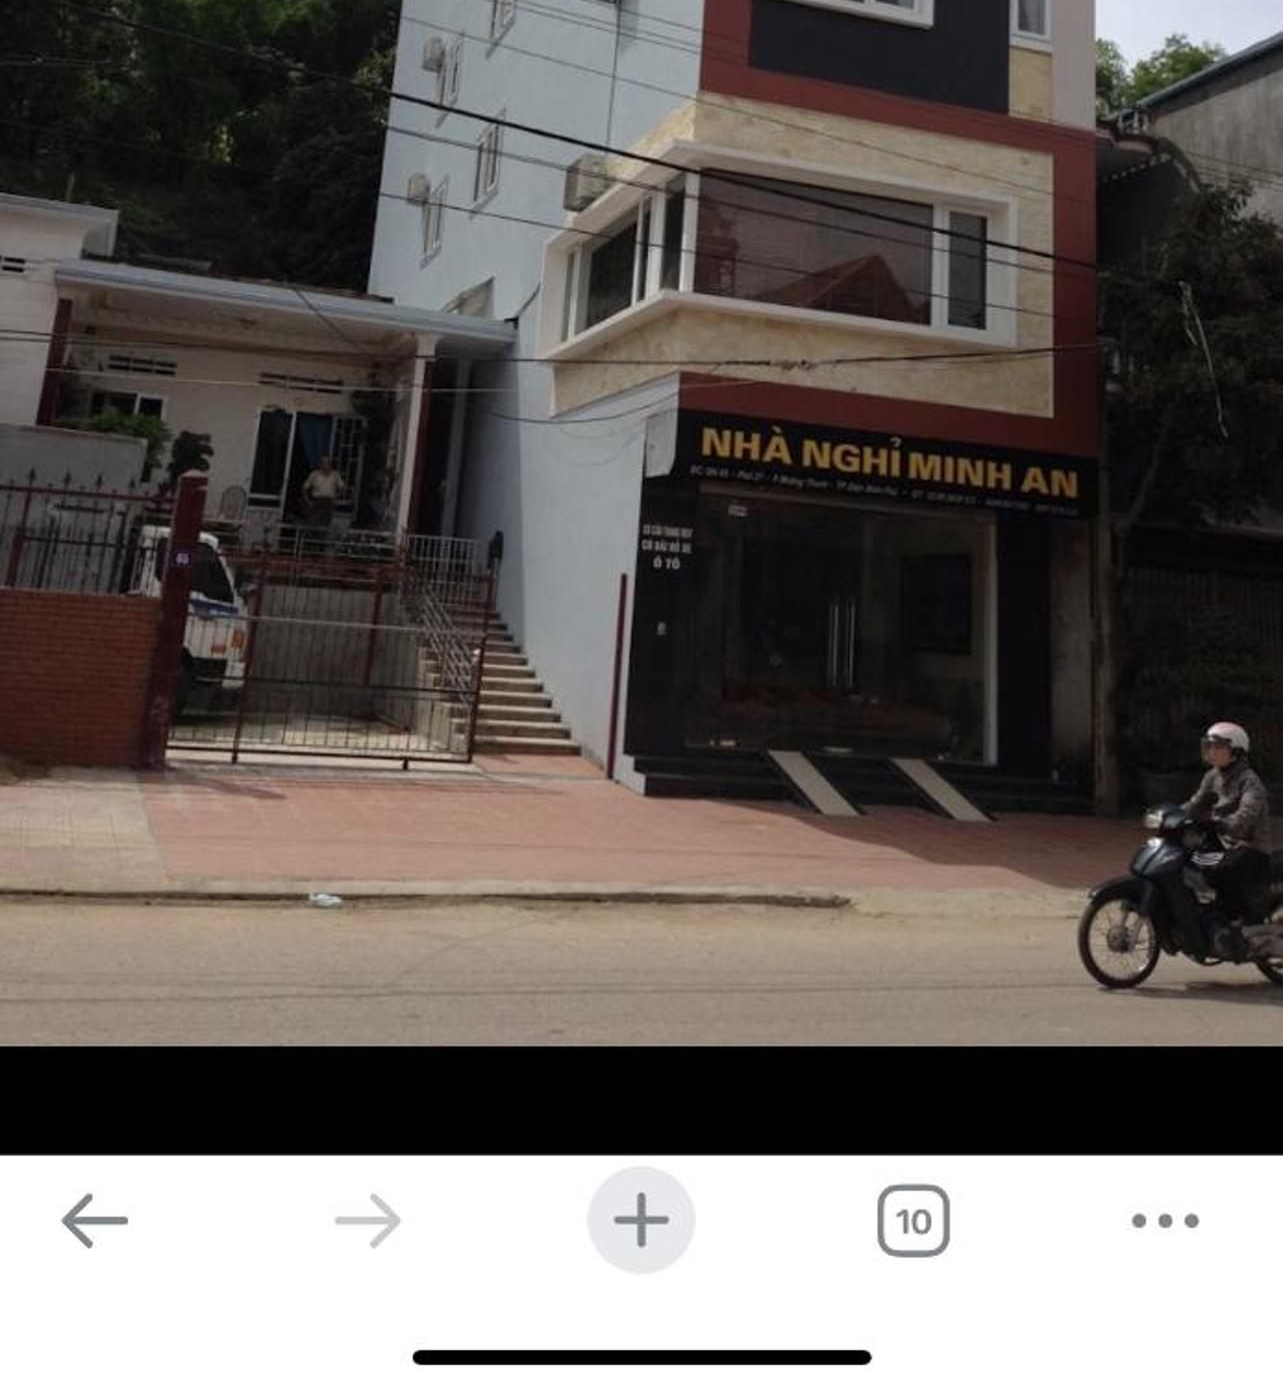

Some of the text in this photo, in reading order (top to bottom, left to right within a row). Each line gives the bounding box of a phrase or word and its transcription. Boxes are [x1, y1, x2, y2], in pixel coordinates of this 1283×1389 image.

[702, 426, 791, 464] NHÀ
[804, 437, 901, 477] NGHỈ
[907, 453, 1011, 490] MINH
[1021, 467, 1078, 499] AN
[896, 1209, 932, 1235] 10
